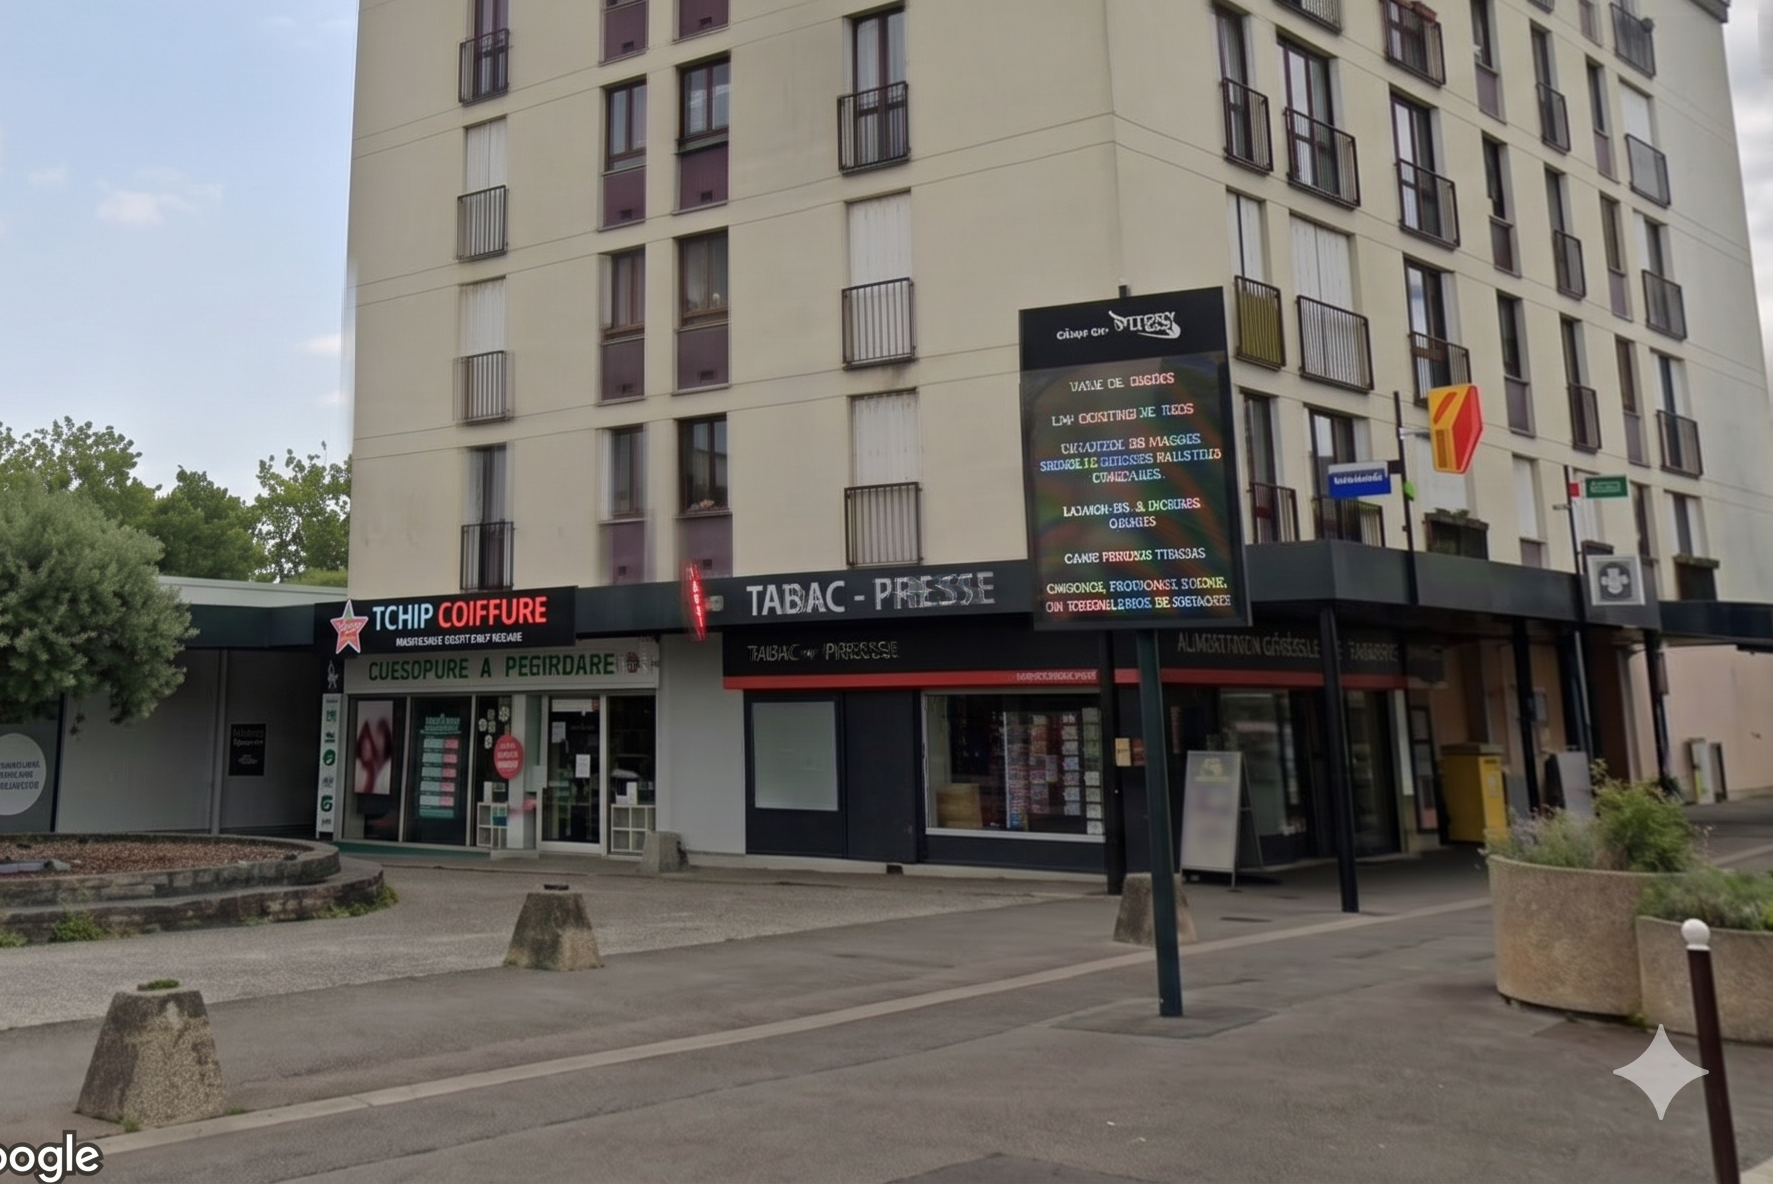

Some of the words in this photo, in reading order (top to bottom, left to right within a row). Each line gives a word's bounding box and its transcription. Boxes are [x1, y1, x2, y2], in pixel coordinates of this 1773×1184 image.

[372, 603, 433, 631] TCHIP
[438, 596, 547, 629] COIFFURE
[746, 580, 845, 616] TABAC
[480, 656, 492, 678] A
